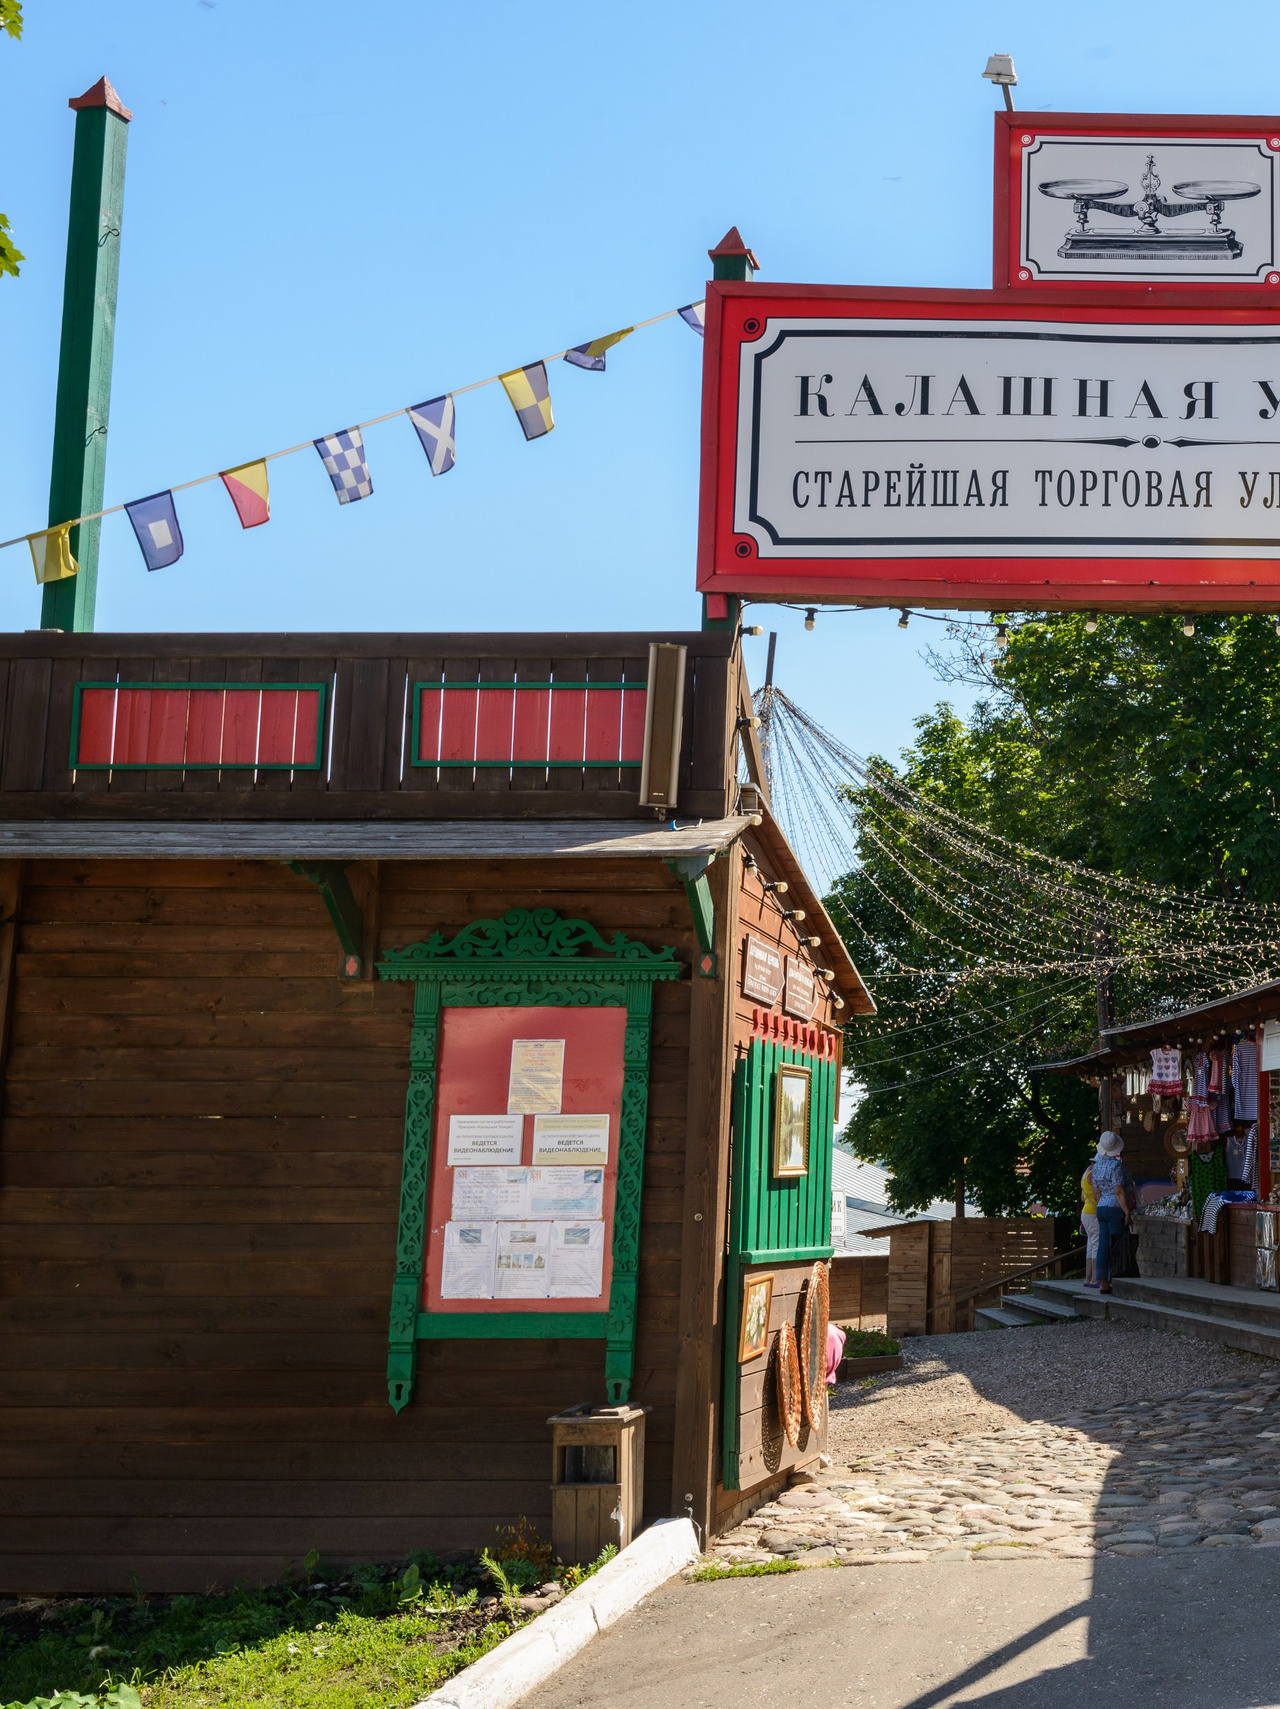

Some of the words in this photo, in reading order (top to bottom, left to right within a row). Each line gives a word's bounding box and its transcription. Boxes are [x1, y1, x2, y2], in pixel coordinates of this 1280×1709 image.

[793, 373, 1219, 420] КАЛАШНАЯ
[792, 462, 1010, 508] СТАРЕЙШАЯ
[1034, 469, 1213, 509] ТОРГОВАЯ
